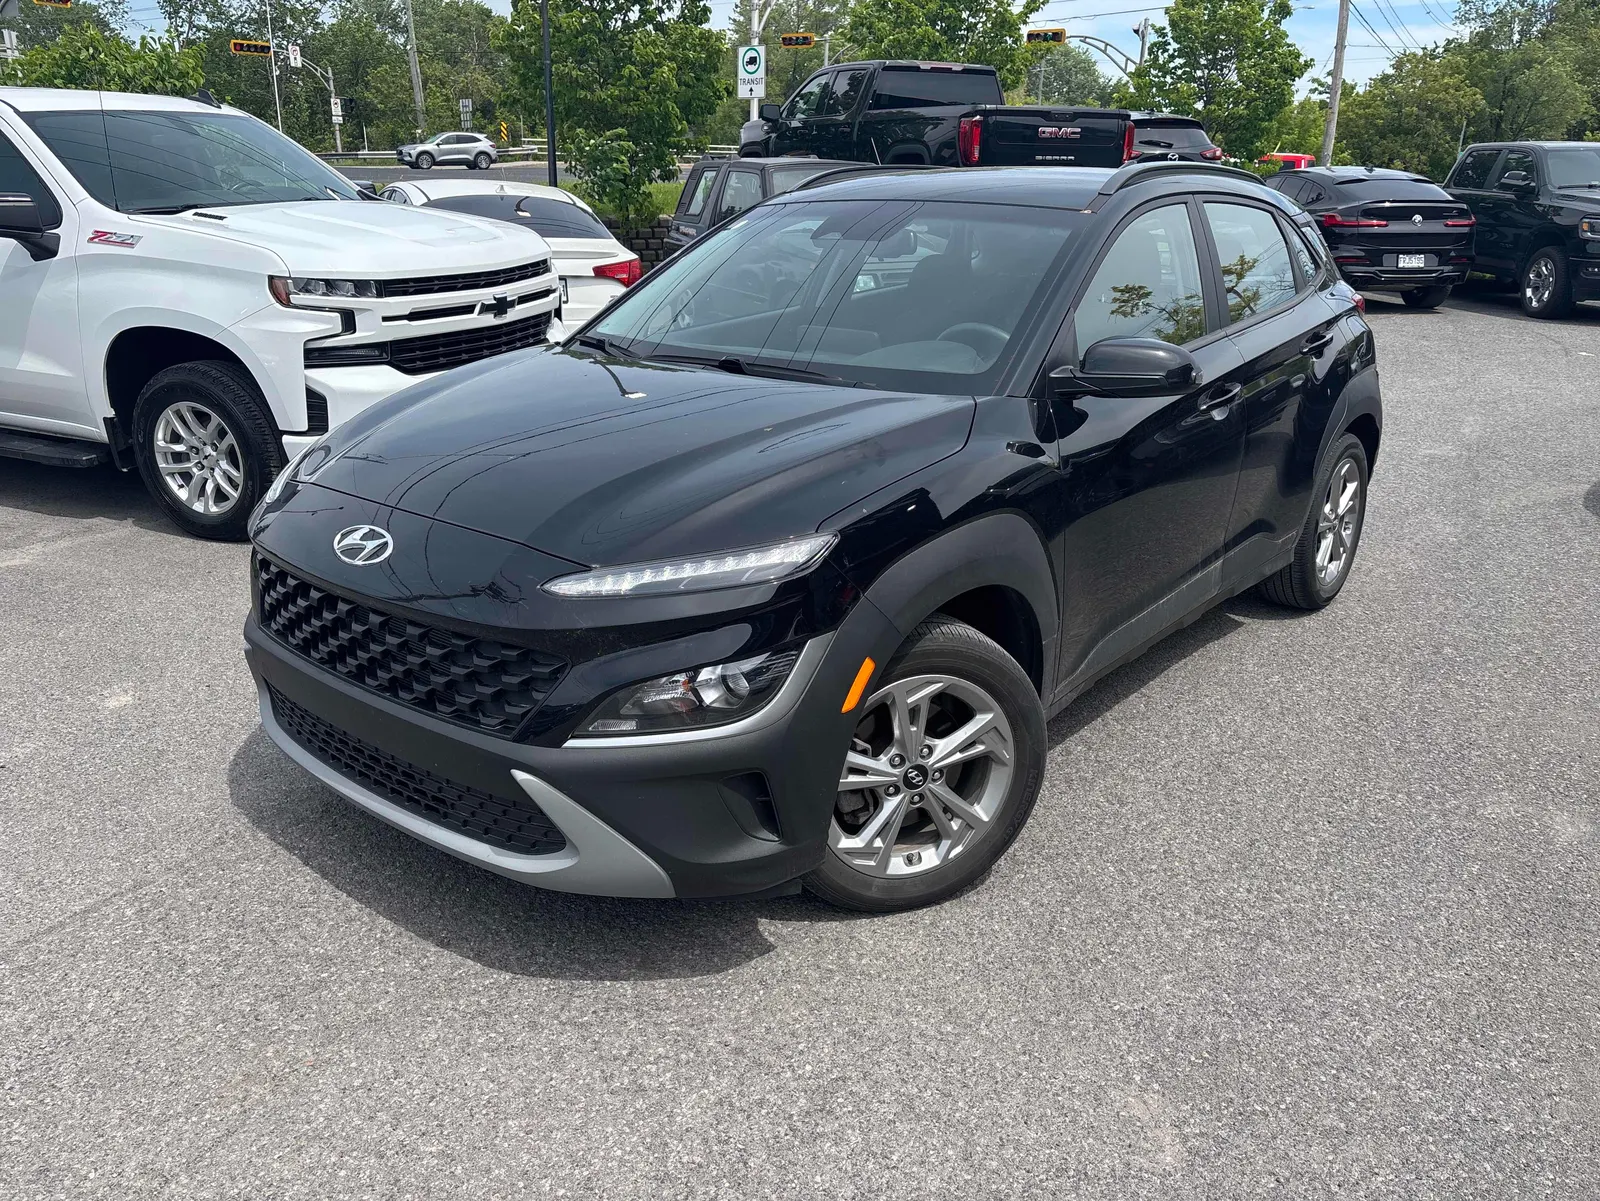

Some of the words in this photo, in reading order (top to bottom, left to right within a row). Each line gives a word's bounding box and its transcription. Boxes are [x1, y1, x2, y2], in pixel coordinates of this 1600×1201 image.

[739, 77, 764, 86] TRANSIT
[1038, 127, 1081, 139] GMC
[87, 229, 144, 249] Z71
